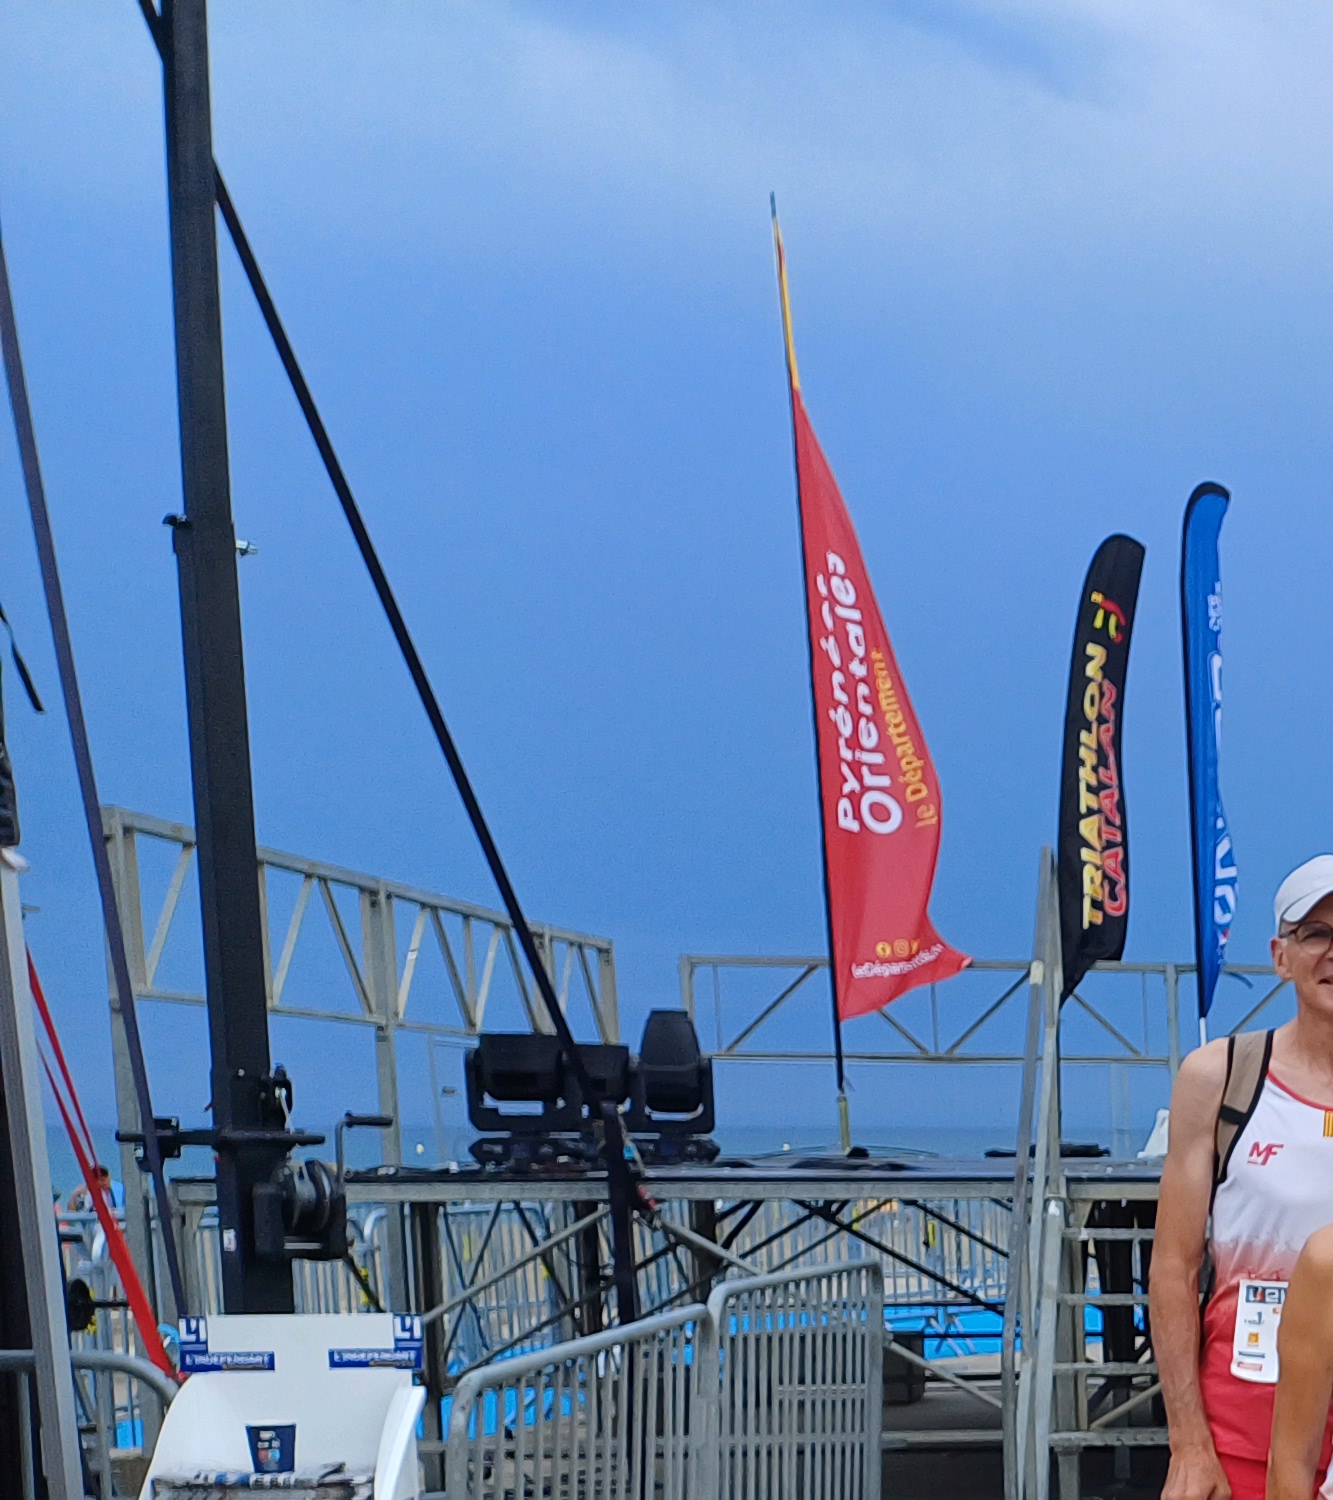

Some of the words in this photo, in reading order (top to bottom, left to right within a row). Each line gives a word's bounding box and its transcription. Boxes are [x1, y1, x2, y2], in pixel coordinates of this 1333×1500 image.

[826, 550, 902, 834] Orientales
[915, 801, 938, 829] le
[1078, 642, 1107, 930] TRIATHLON
[1098, 679, 1128, 918] CATALAN
